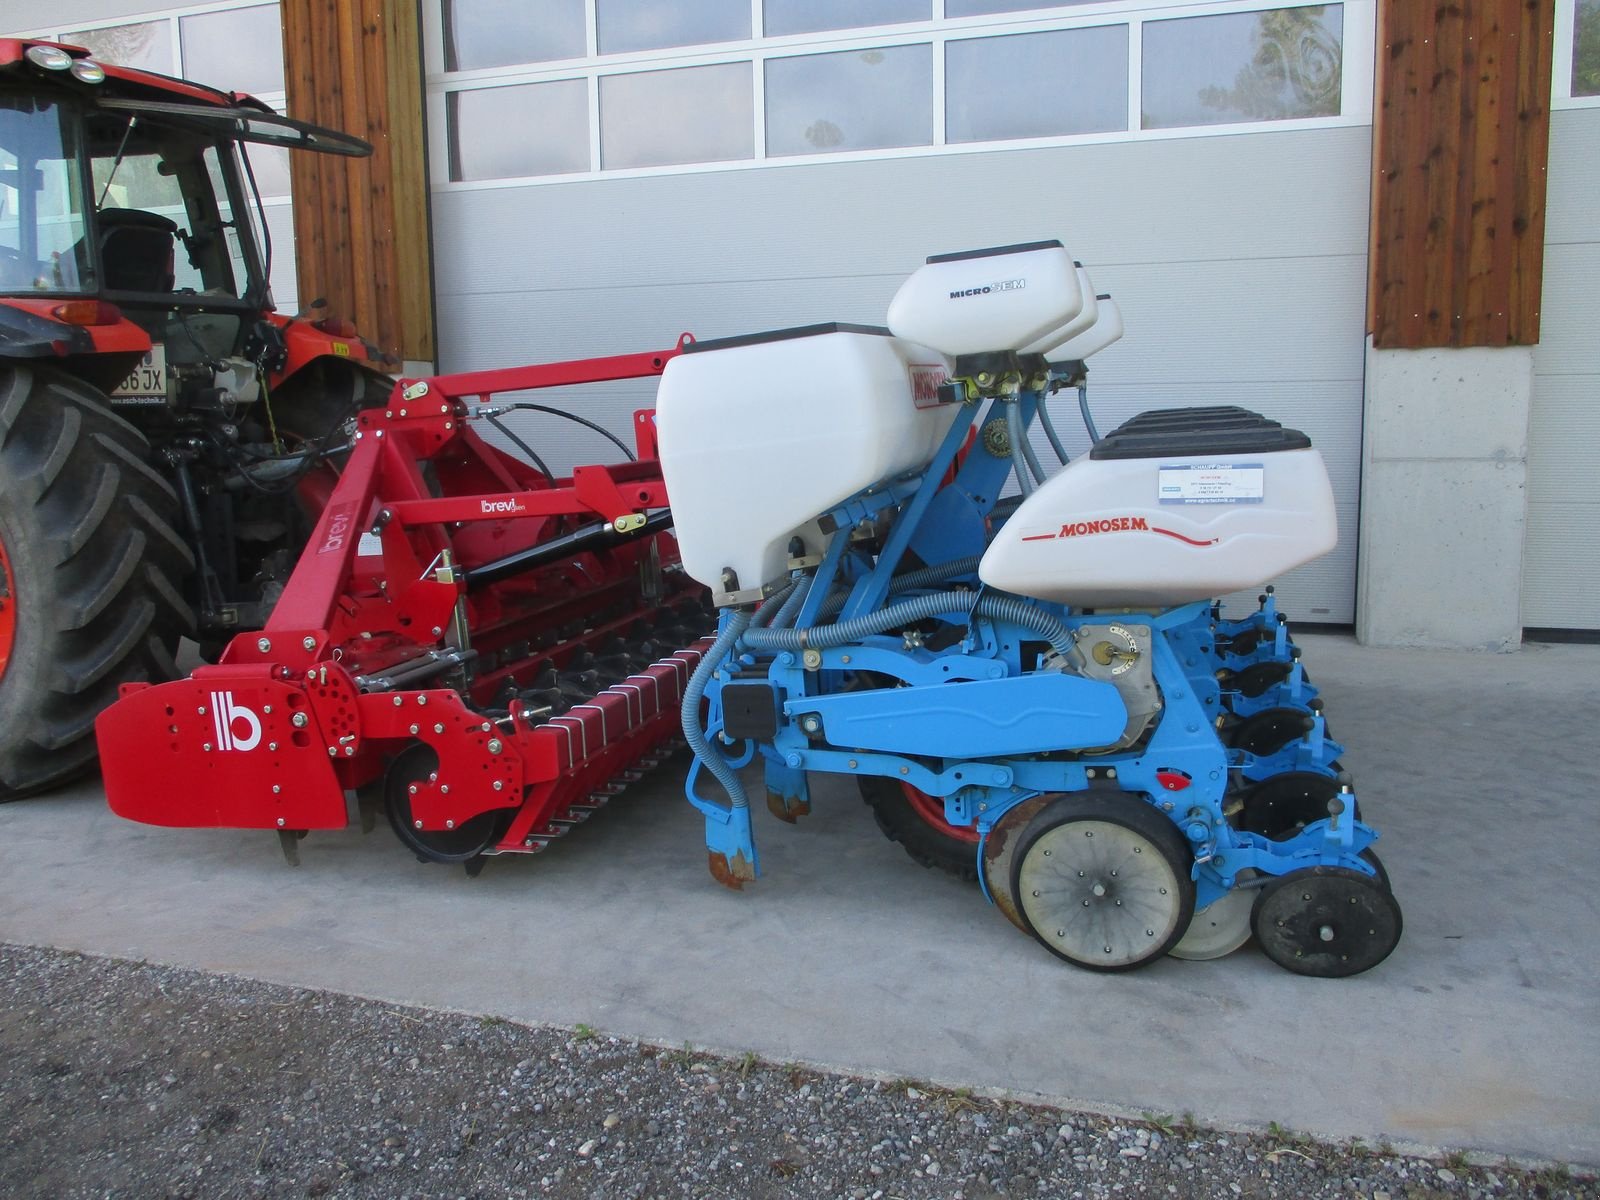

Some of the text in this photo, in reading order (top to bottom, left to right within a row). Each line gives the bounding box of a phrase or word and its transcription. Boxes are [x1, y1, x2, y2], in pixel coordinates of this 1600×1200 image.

[950, 279, 1025, 299] MICROSEM
[143, 369, 162, 390] JX
[1059, 517, 1149, 538] MONOSEM
